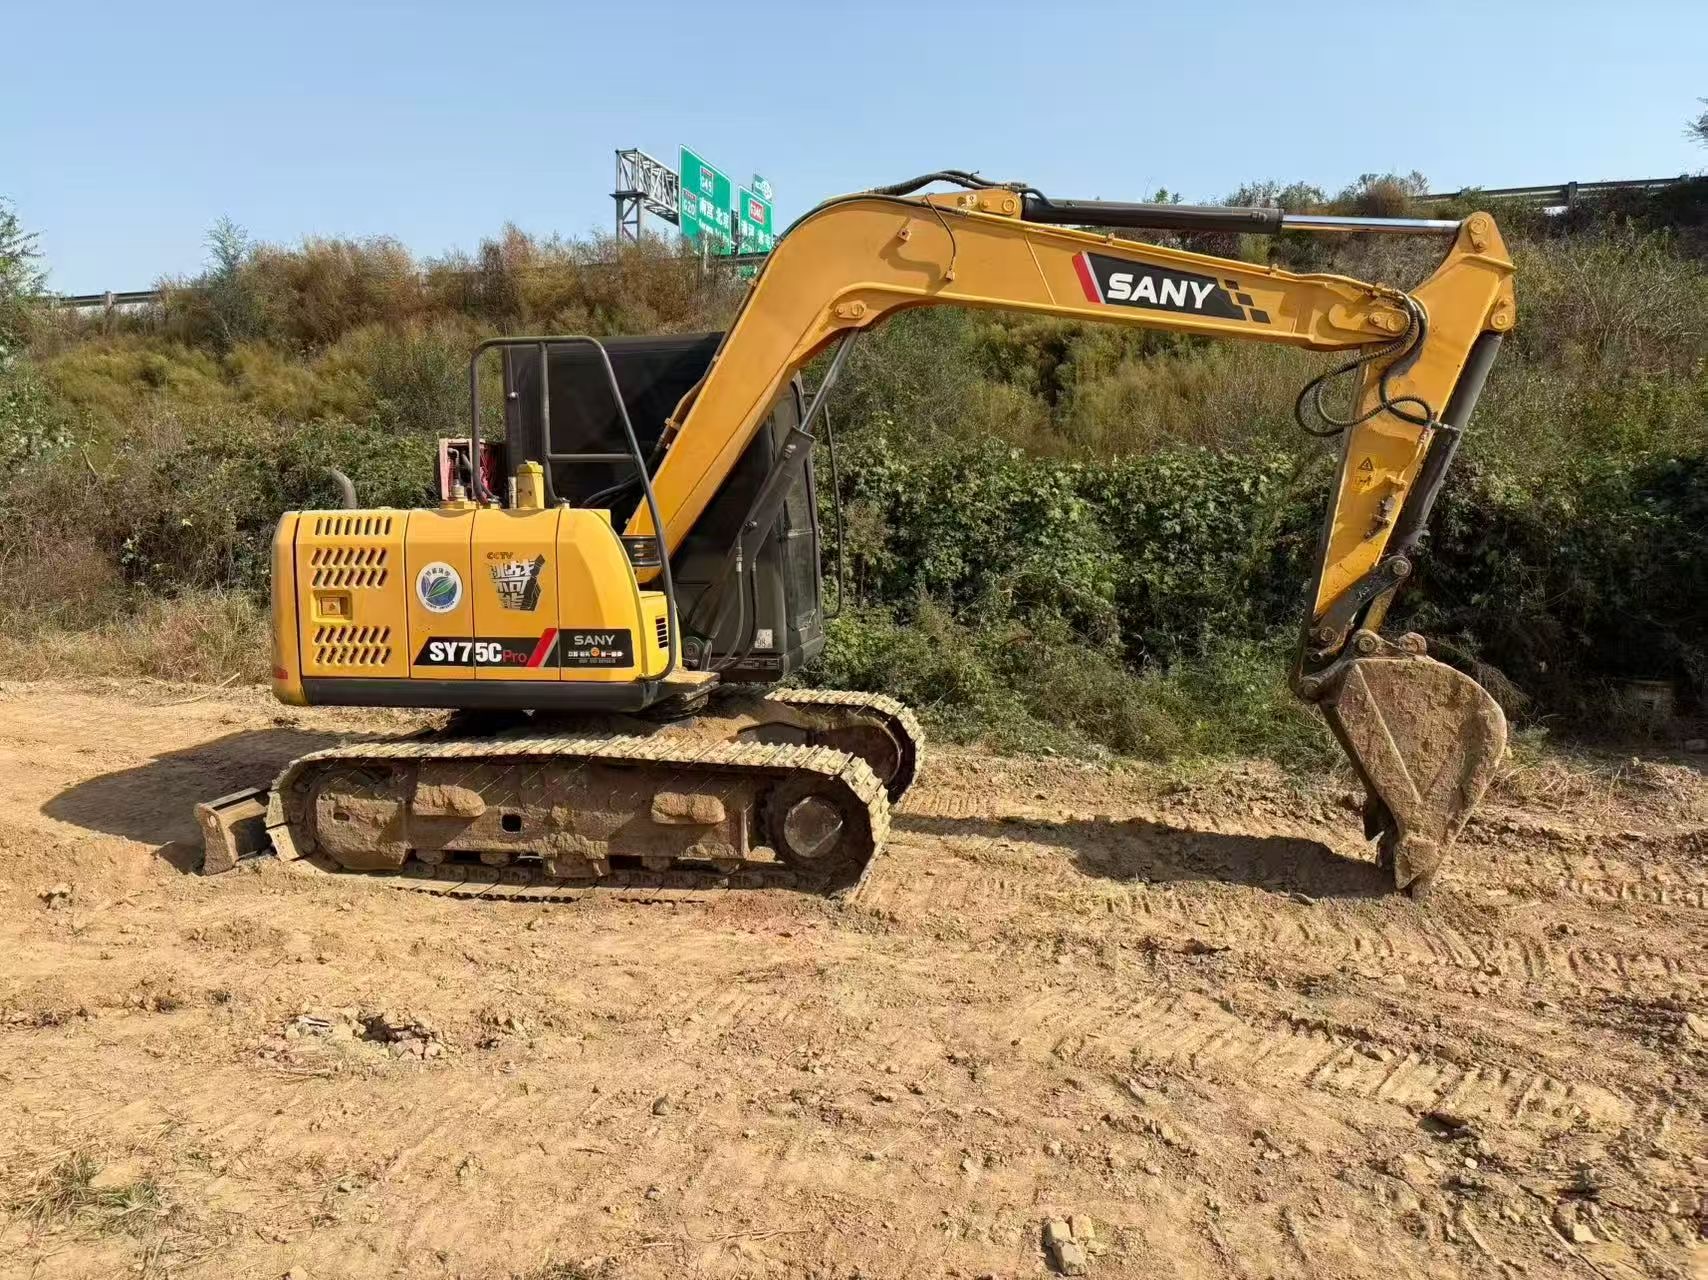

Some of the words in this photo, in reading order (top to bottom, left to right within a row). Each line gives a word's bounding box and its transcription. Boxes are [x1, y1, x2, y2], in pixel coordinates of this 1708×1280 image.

[1107, 272, 1216, 308] SANY
[486, 551, 514, 560] CCTV
[574, 634, 615, 646] SANY
